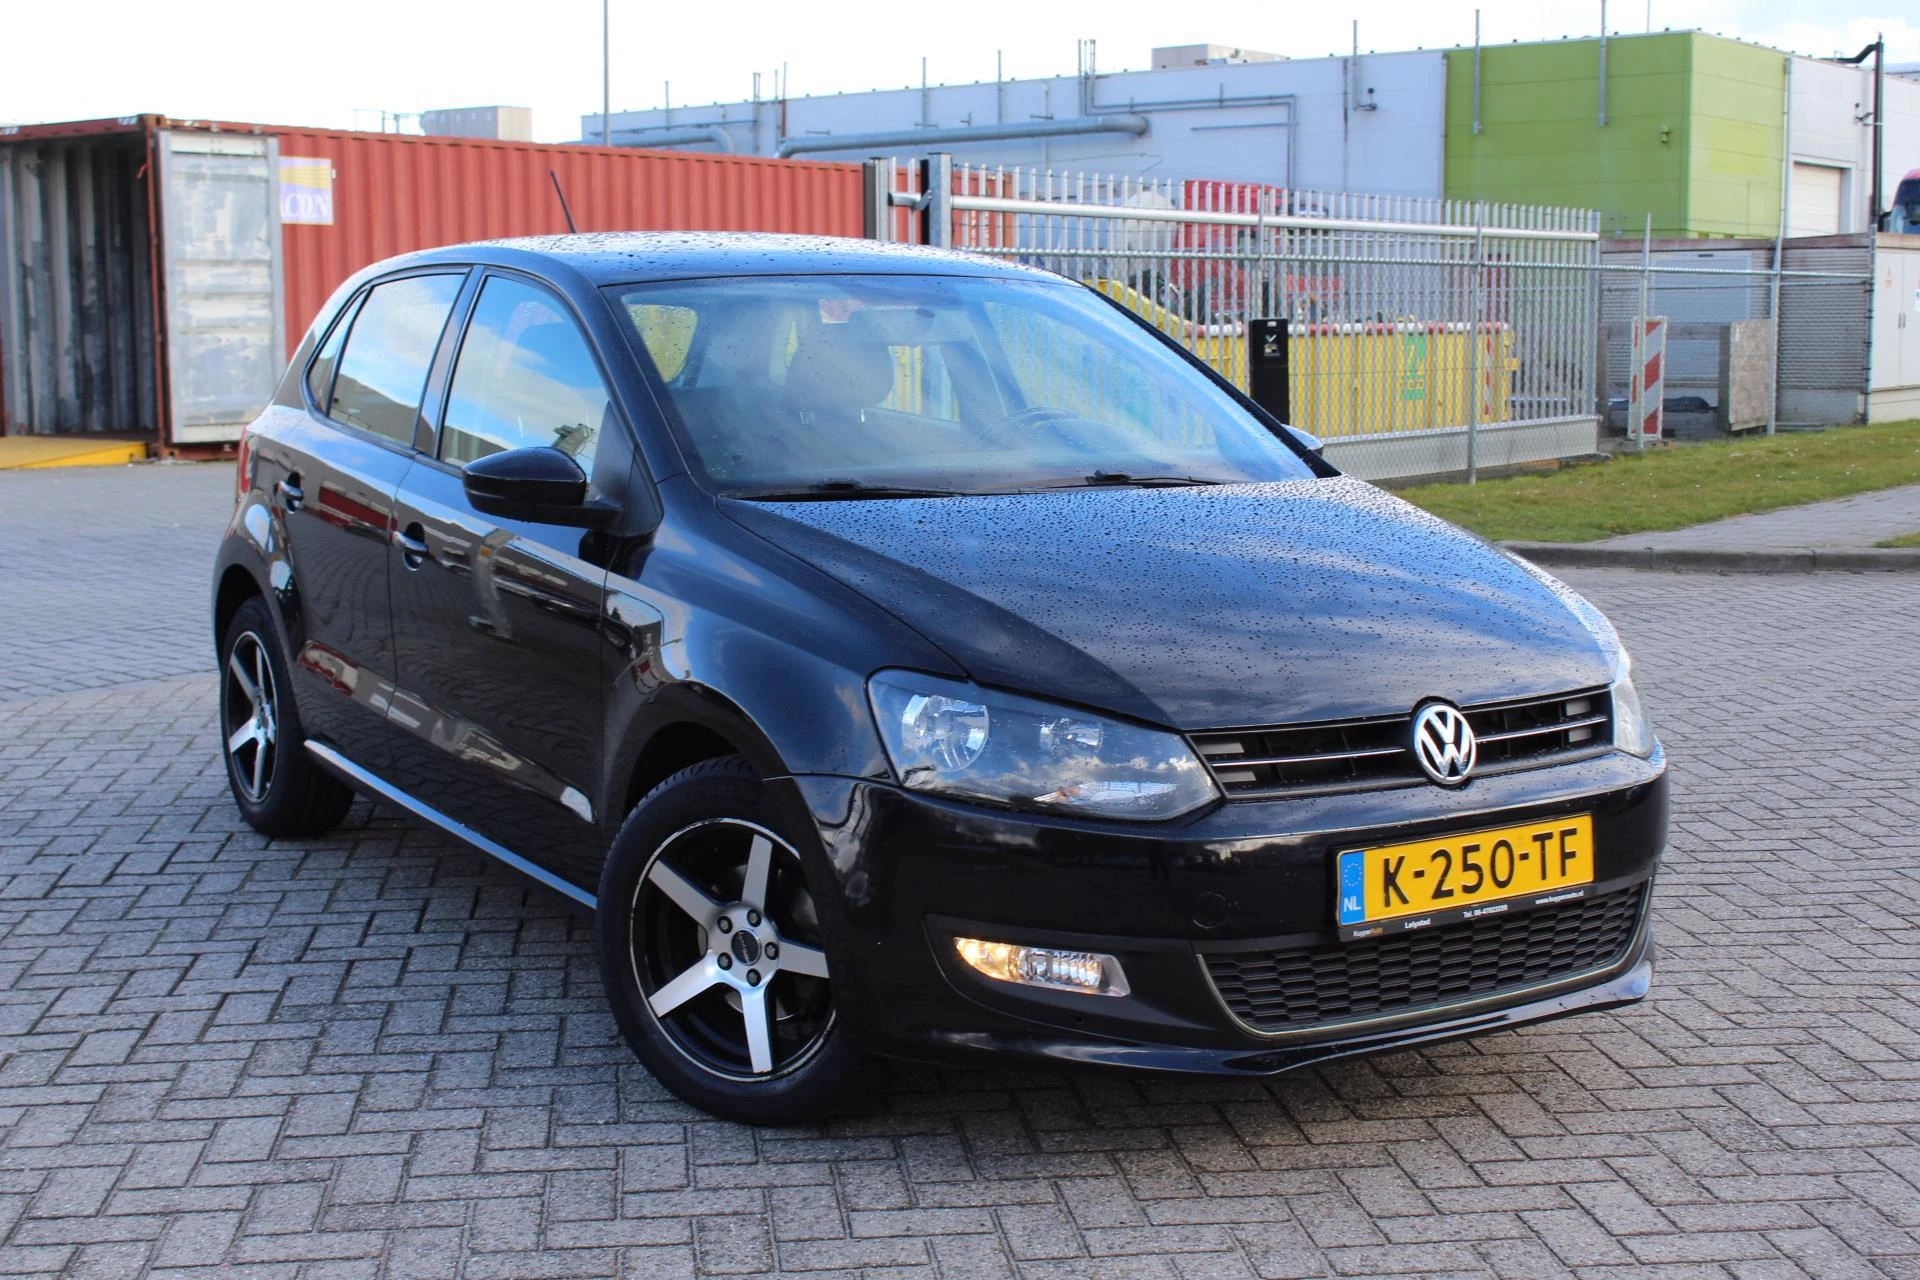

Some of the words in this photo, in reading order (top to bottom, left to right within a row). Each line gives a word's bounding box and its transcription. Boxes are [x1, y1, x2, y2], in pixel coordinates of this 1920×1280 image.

[1383, 827, 1578, 908] K-250-TF
[1343, 896, 1362, 913] NL
[1404, 918, 1431, 930] Lelystad
